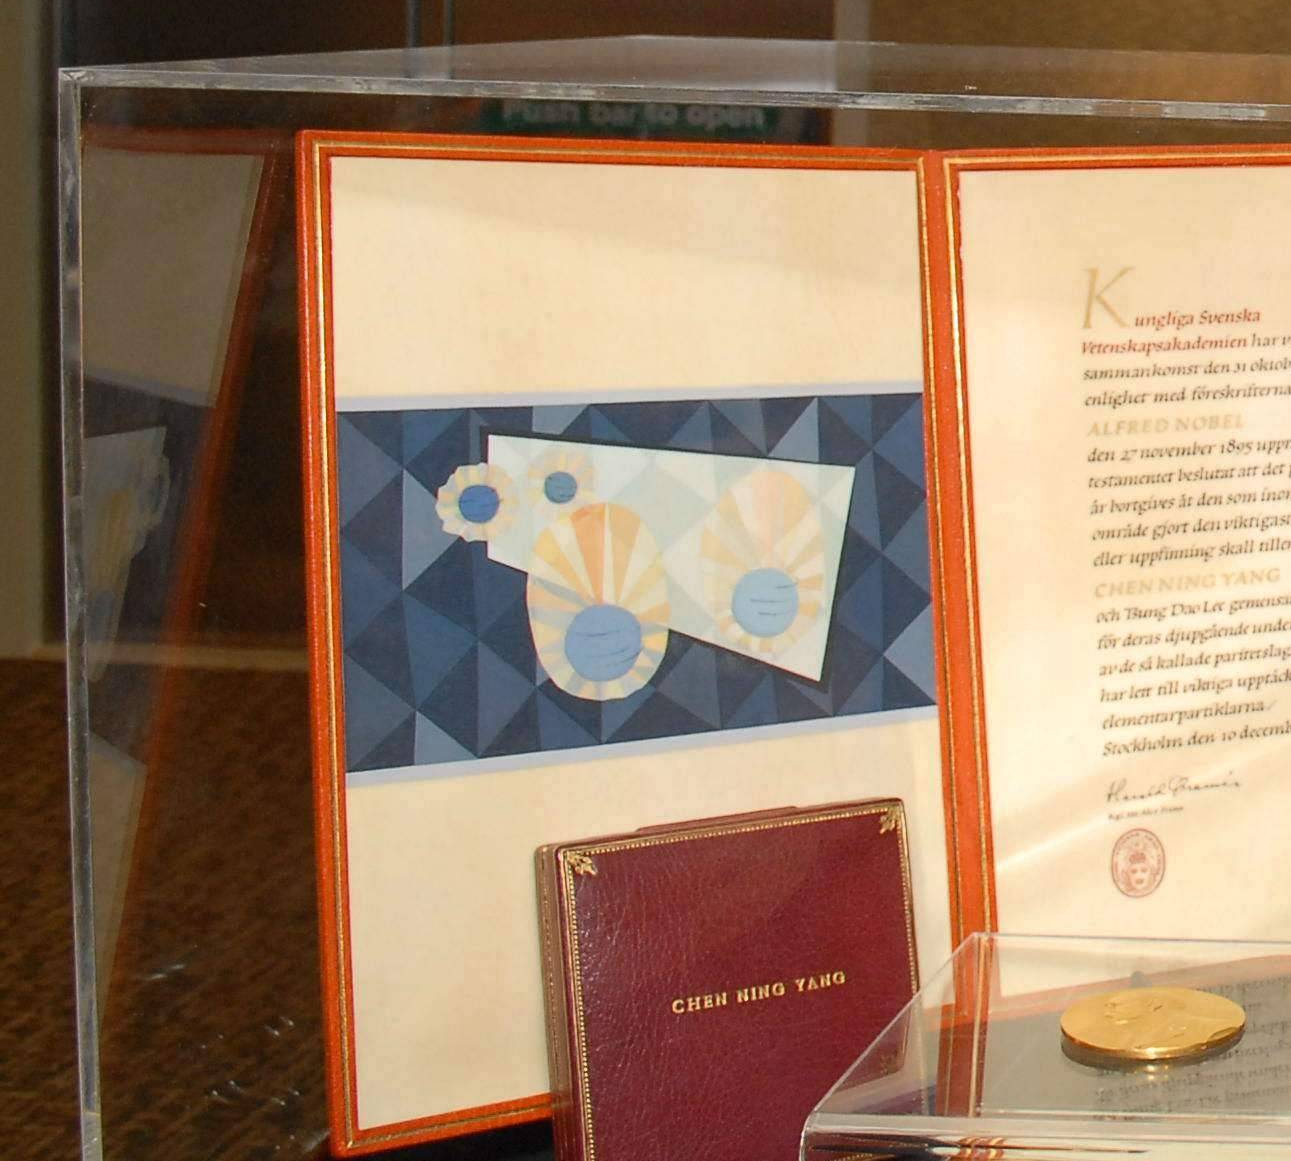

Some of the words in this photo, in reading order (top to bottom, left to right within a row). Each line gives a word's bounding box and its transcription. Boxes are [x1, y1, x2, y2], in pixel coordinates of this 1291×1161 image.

[643, 102, 679, 126] to
[685, 104, 766, 131] open
[1199, 308, 1261, 325] Svenska
[1081, 335, 1248, 357] Vetenskapsakademien
[1251, 333, 1279, 347] har
[1083, 362, 1201, 381] sammankomst
[1203, 361, 1230, 375] den
[1233, 362, 1247, 373] 31
[1084, 389, 1151, 410] enlighet
[1153, 386, 1186, 404] med
[1087, 418, 1170, 437] ALFRED
[1174, 413, 1244, 432] NOBEL
[1087, 447, 1116, 462] den
[1139, 441, 1217, 460] november
[1220, 438, 1253, 455] 1895
[1088, 471, 1176, 489] testamentet
[1178, 466, 1236, 483] beslutat
[1237, 464, 1260, 479] att
[1261, 461, 1286, 477] det
[1110, 495, 1176, 516] bortgives
[1196, 492, 1223, 507] den
[1226, 491, 1257, 505] som
[1151, 519, 1190, 541] gjort
[1192, 517, 1221, 533] den
[1093, 550, 1128, 567] eller
[1219, 539, 1254, 557] skall
[1095, 579, 1153, 598] CHEN
[1157, 573, 1217, 593] NING
[1221, 568, 1281, 587] YANG
[1096, 607, 1121, 624] och
[1170, 602, 1201, 617] Dao
[1202, 600, 1225, 614] Lee
[1098, 633, 1121, 650] för
[1122, 633, 1161, 647] deras
[1099, 663, 1118, 677] av
[1119, 659, 1136, 674] de
[1156, 652, 1212, 671] kallade
[1100, 688, 1126, 703] har
[1102, 735, 1184, 756] Stockholm
[1187, 730, 1216, 746] den
[671, 991, 728, 1015] CHEN
[736, 981, 787, 1004] NING
[794, 970, 847, 993] YANG
